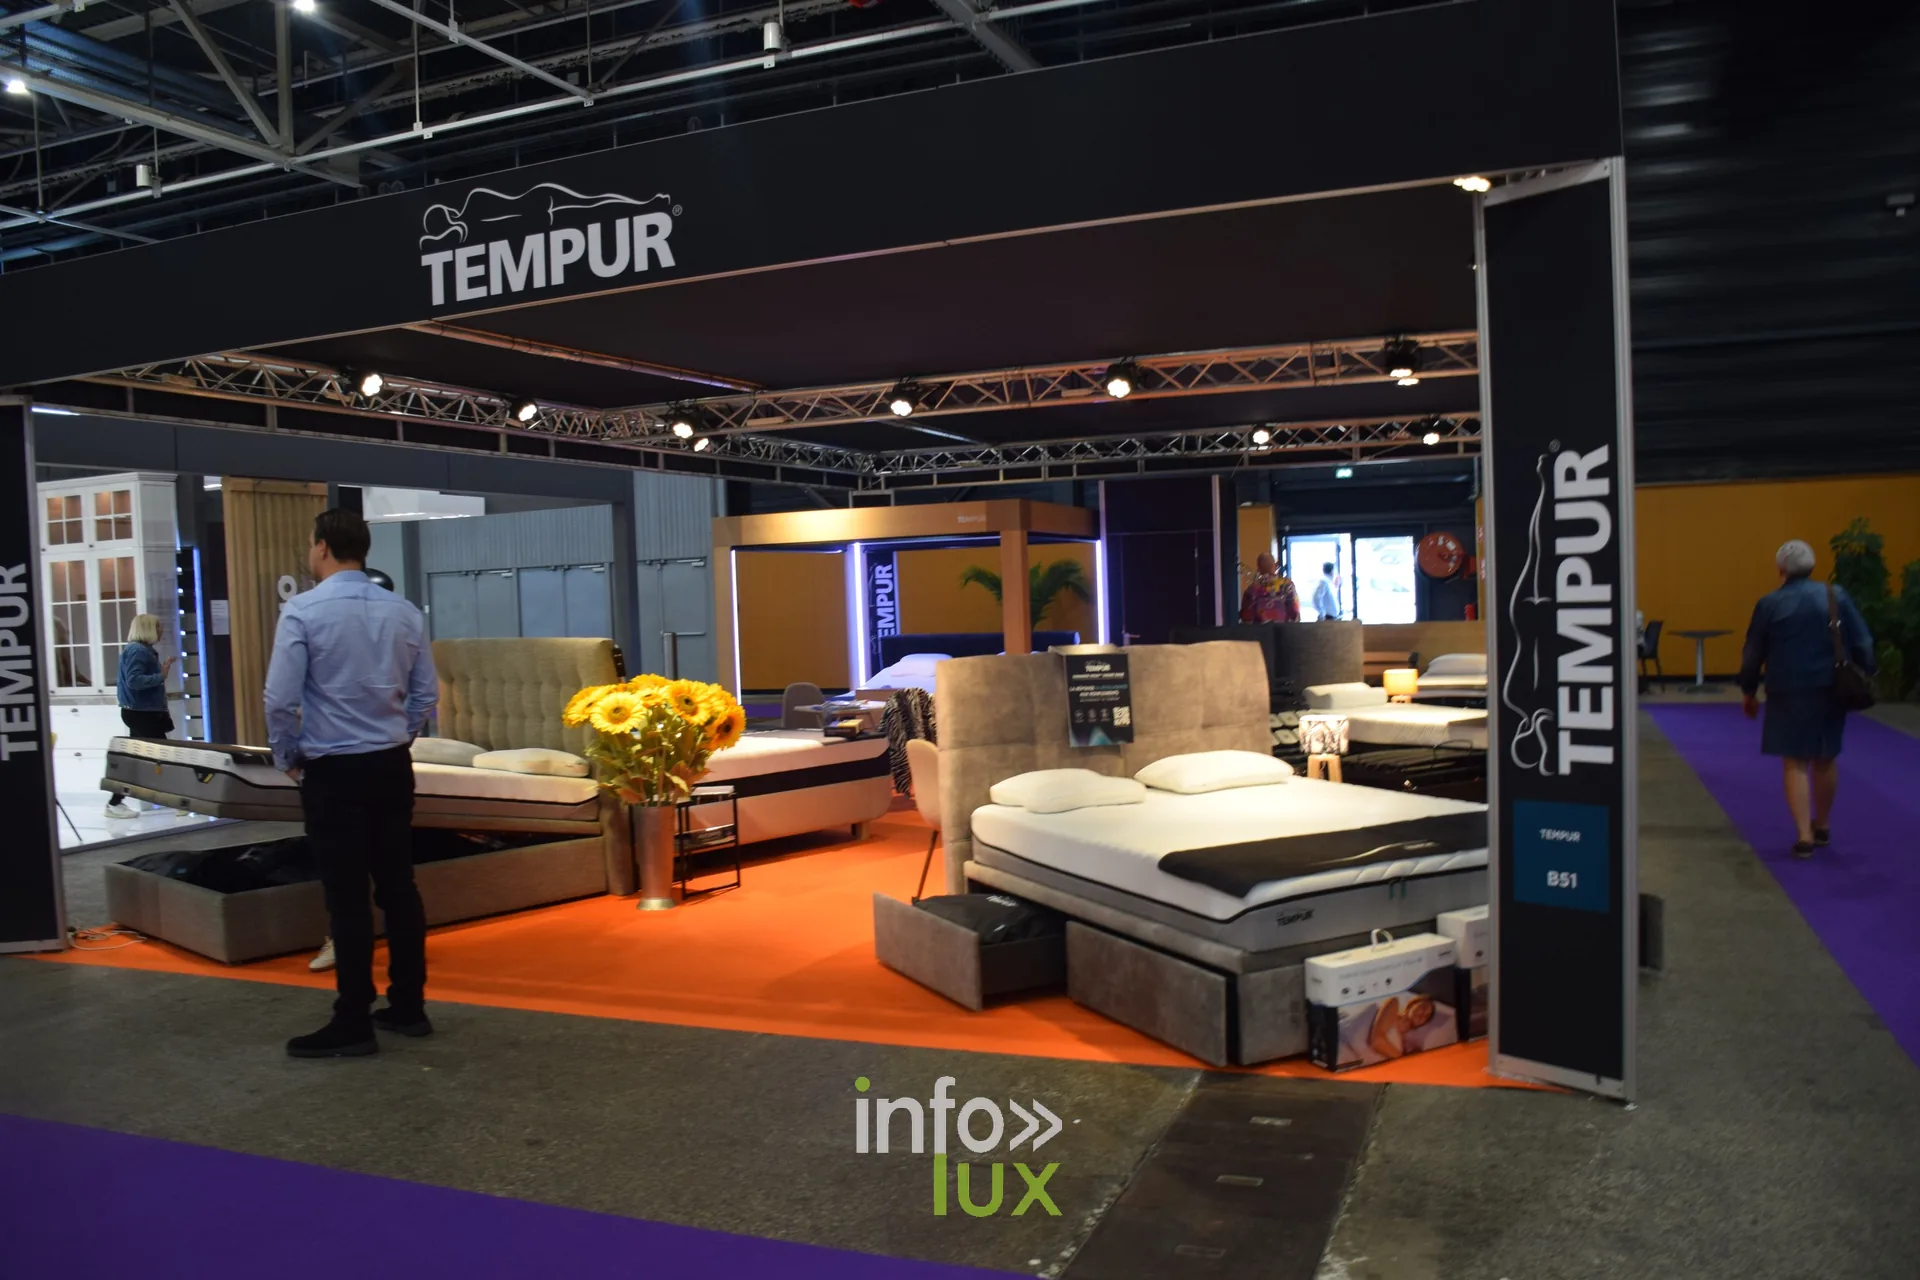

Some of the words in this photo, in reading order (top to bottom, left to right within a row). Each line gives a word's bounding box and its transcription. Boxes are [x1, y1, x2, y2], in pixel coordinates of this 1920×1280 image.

[421, 212, 676, 306] TEMPUR
[874, 564, 896, 642] EMPUR
[1554, 444, 1614, 775] TEMPUR
[0, 563, 38, 761] TEMPUR
[1539, 828, 1581, 842] TEMPUR
[1546, 870, 1578, 889] B51
